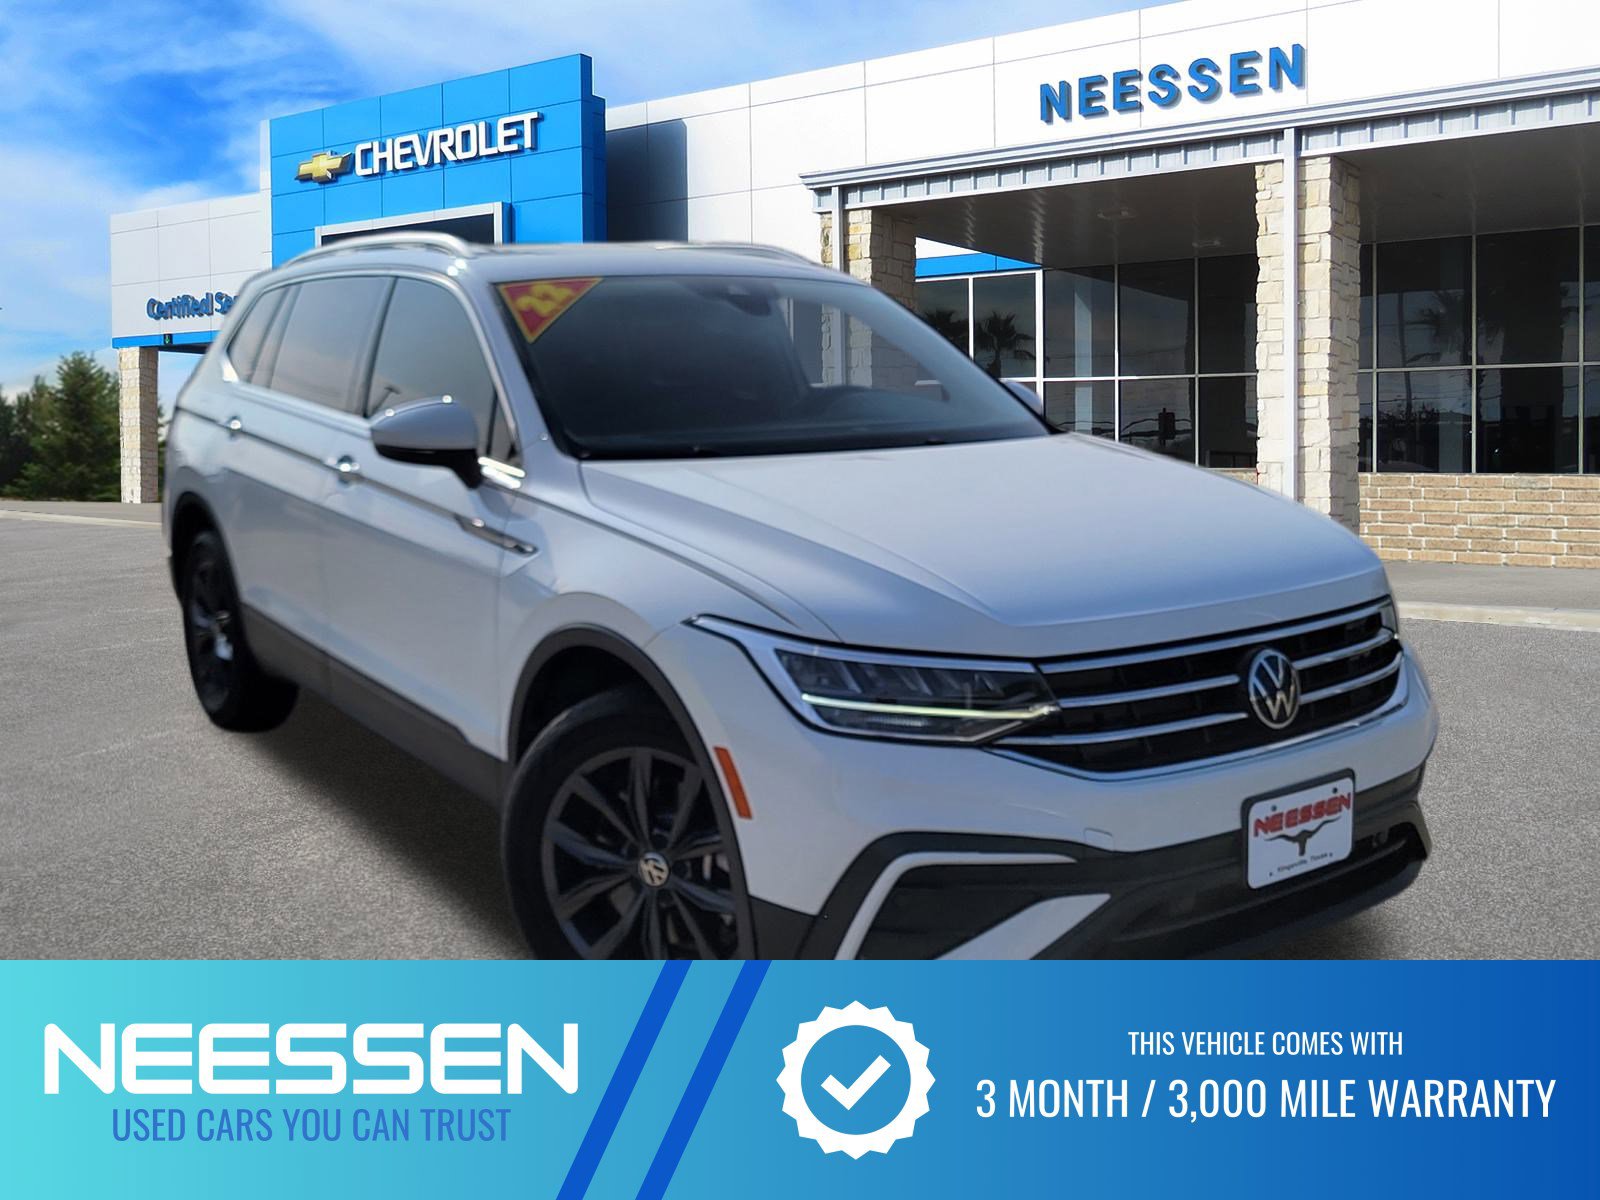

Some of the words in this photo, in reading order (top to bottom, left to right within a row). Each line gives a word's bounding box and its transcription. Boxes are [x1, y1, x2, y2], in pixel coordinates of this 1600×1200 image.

[1039, 43, 1305, 124] NEESSEN
[354, 111, 543, 178] CHEVROLET
[146, 292, 214, 321] Certified
[1253, 792, 1351, 837] NEESSEN
